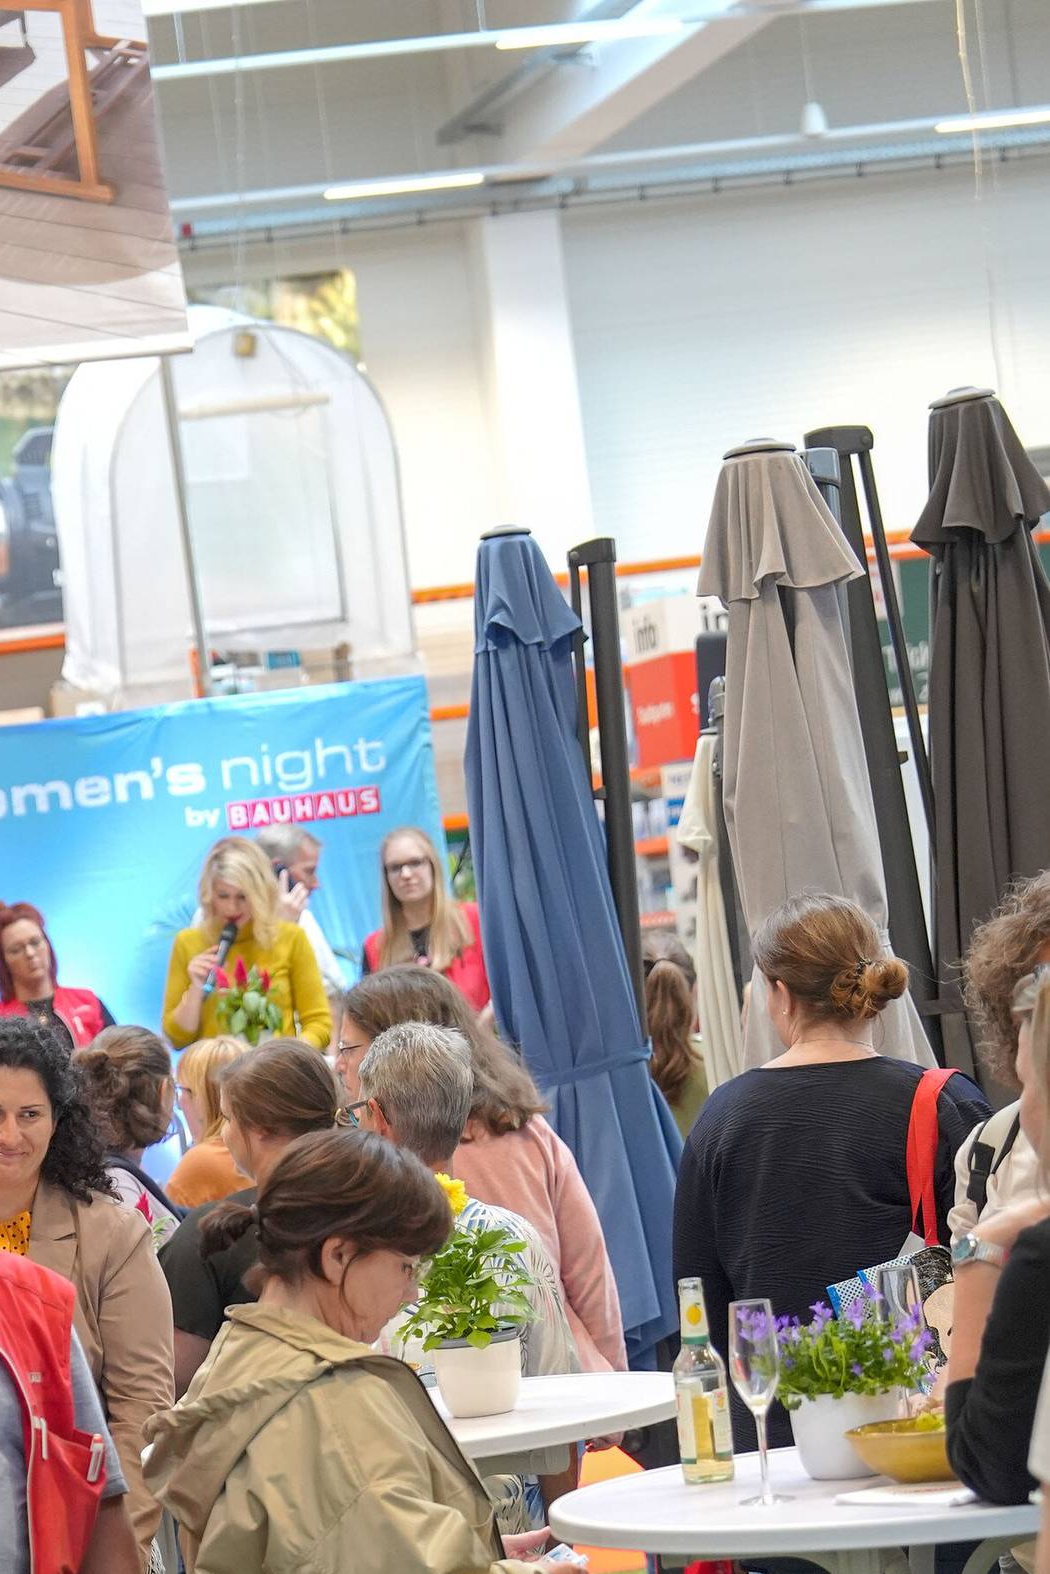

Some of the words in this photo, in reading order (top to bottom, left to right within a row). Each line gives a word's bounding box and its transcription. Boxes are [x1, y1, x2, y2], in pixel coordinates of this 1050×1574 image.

[220, 737, 387, 792] night
[184, 805, 221, 829] by
[227, 787, 381, 829] BAUHAUS
